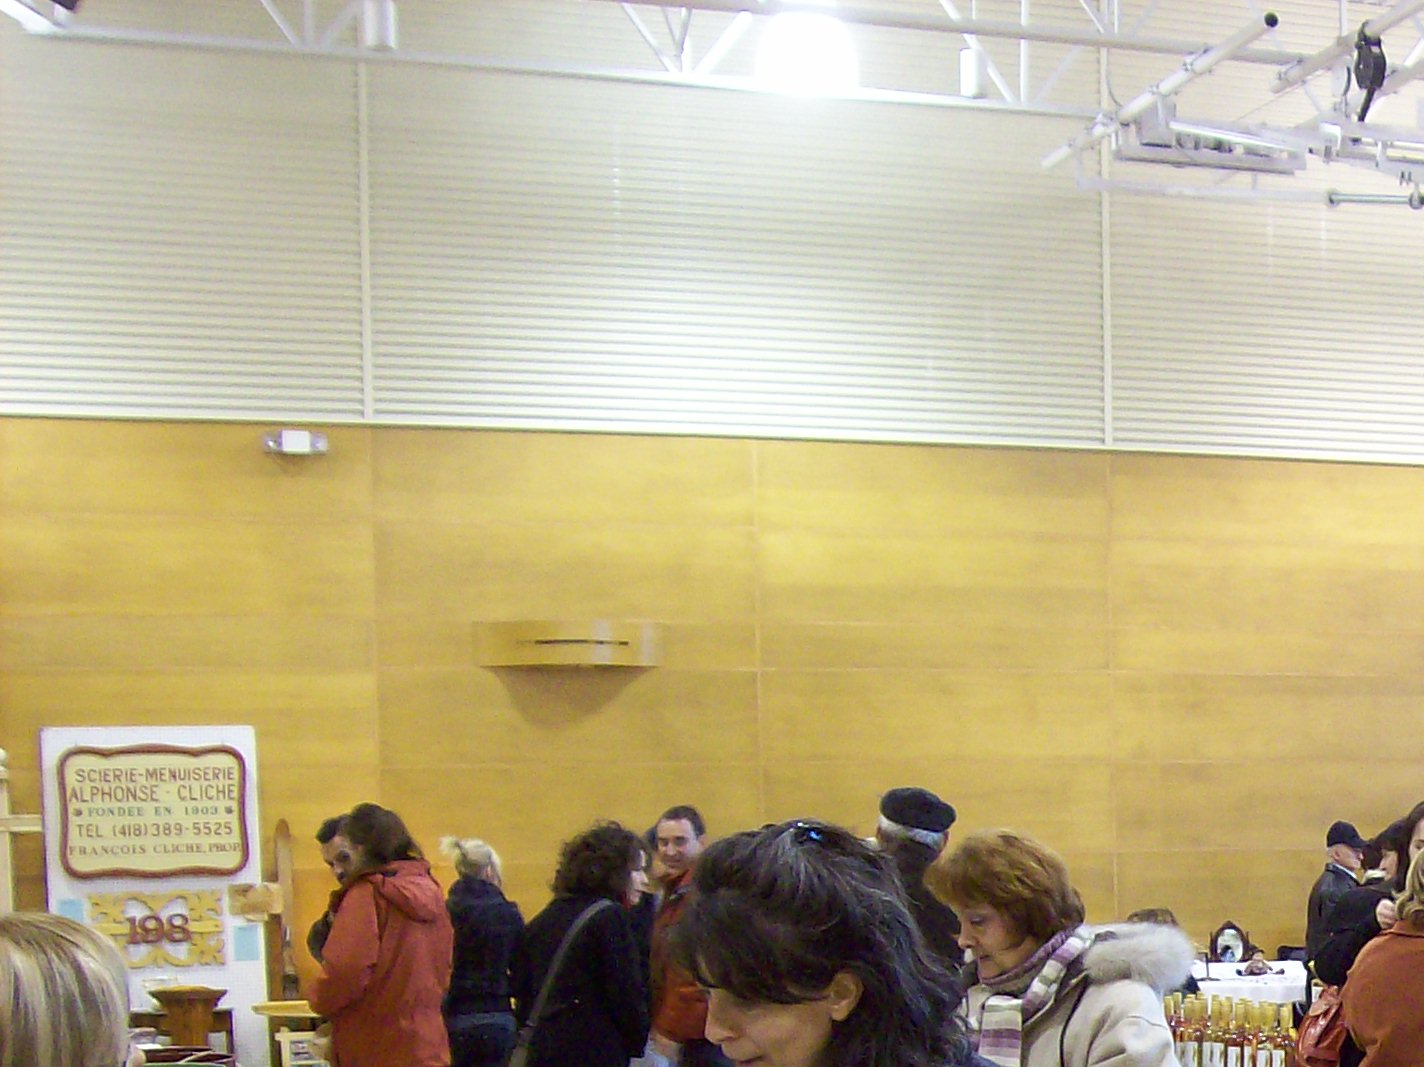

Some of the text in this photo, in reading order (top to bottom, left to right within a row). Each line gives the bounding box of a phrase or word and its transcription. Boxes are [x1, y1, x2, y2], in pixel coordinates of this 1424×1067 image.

[74, 767, 236, 783] SCIERIE-MENUISERIE
[69, 785, 160, 803] ALPHONSE
[177, 783, 237, 801] CLICHE
[87, 806, 145, 817] FONDEE
[154, 806, 173, 817] EN
[76, 823, 104, 838] TEL
[126, 913, 192, 944] 198
